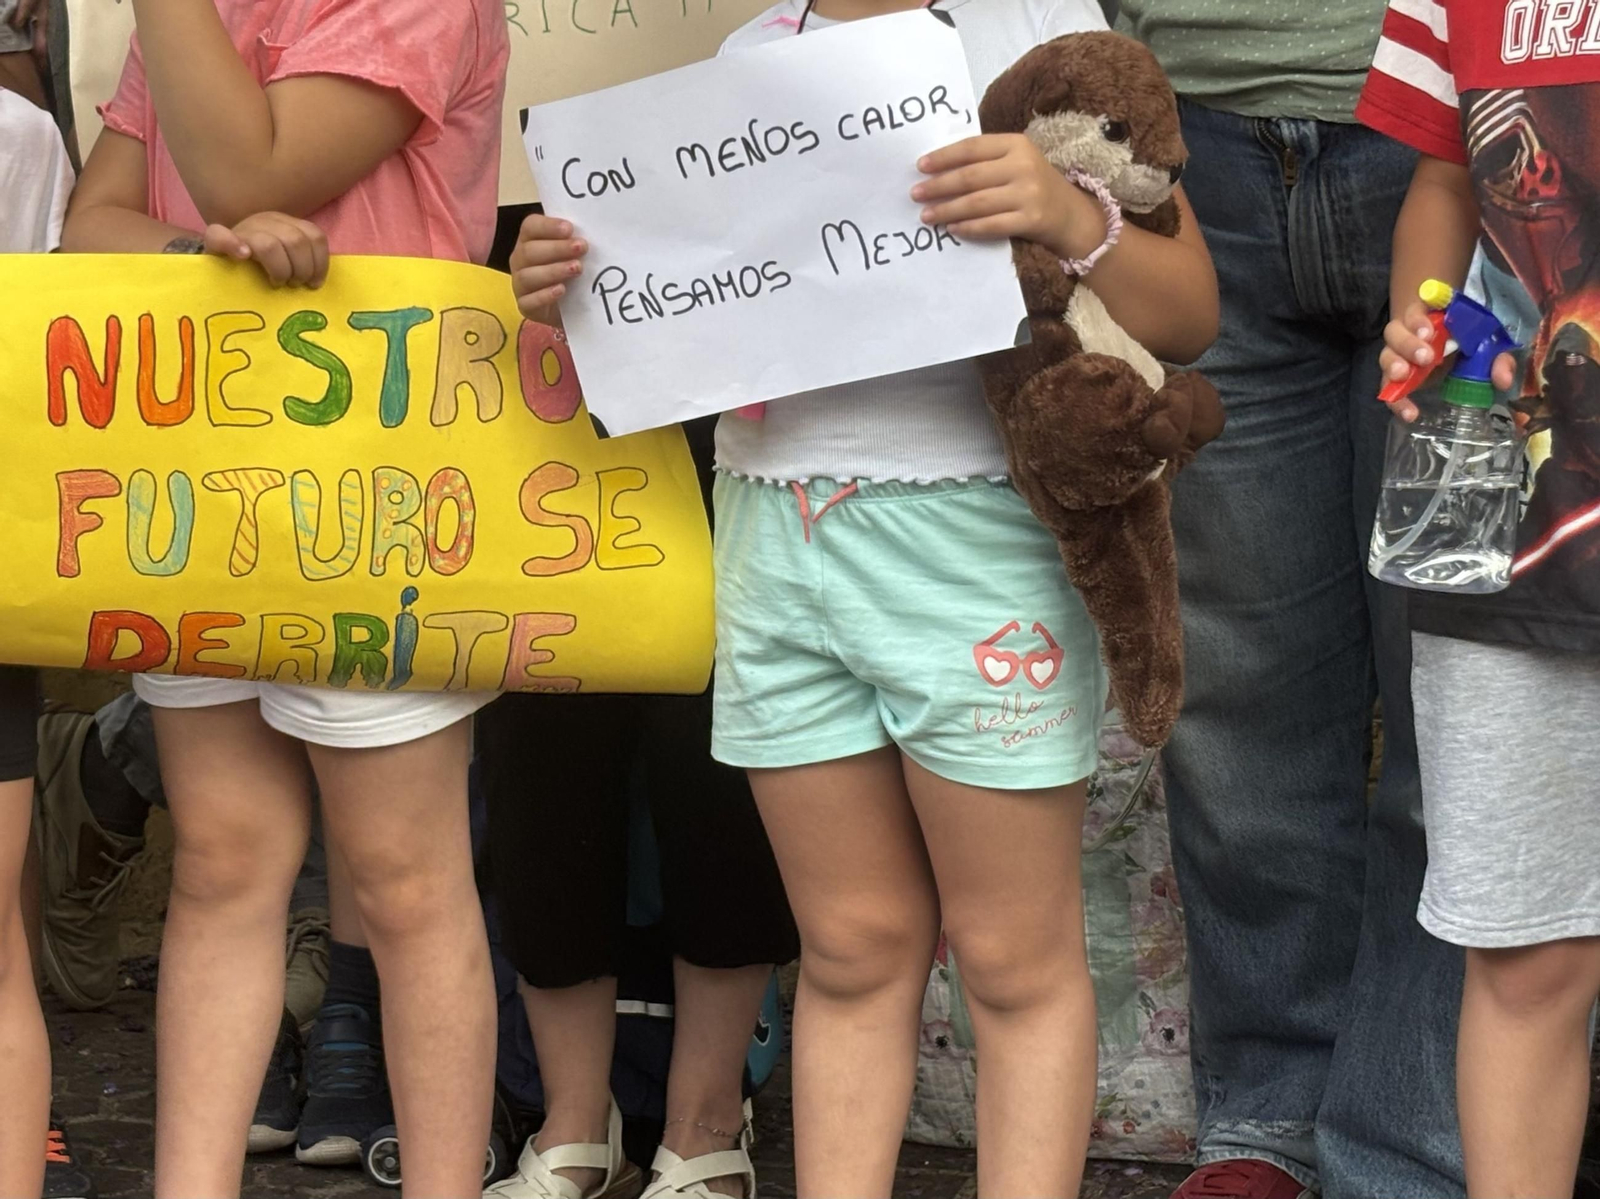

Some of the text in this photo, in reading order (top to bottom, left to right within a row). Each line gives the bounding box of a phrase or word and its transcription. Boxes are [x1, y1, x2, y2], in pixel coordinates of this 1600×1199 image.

[676, 118, 820, 181] MENOS
[838, 85, 972, 140] CALOR,
[592, 219, 961, 325] PENSAMOS MEJOR
[46, 307, 582, 429] NUESTRO
[56, 461, 665, 581] FUTURO SE
[974, 692, 1045, 733] hello
[1001, 705, 1078, 748] summer
